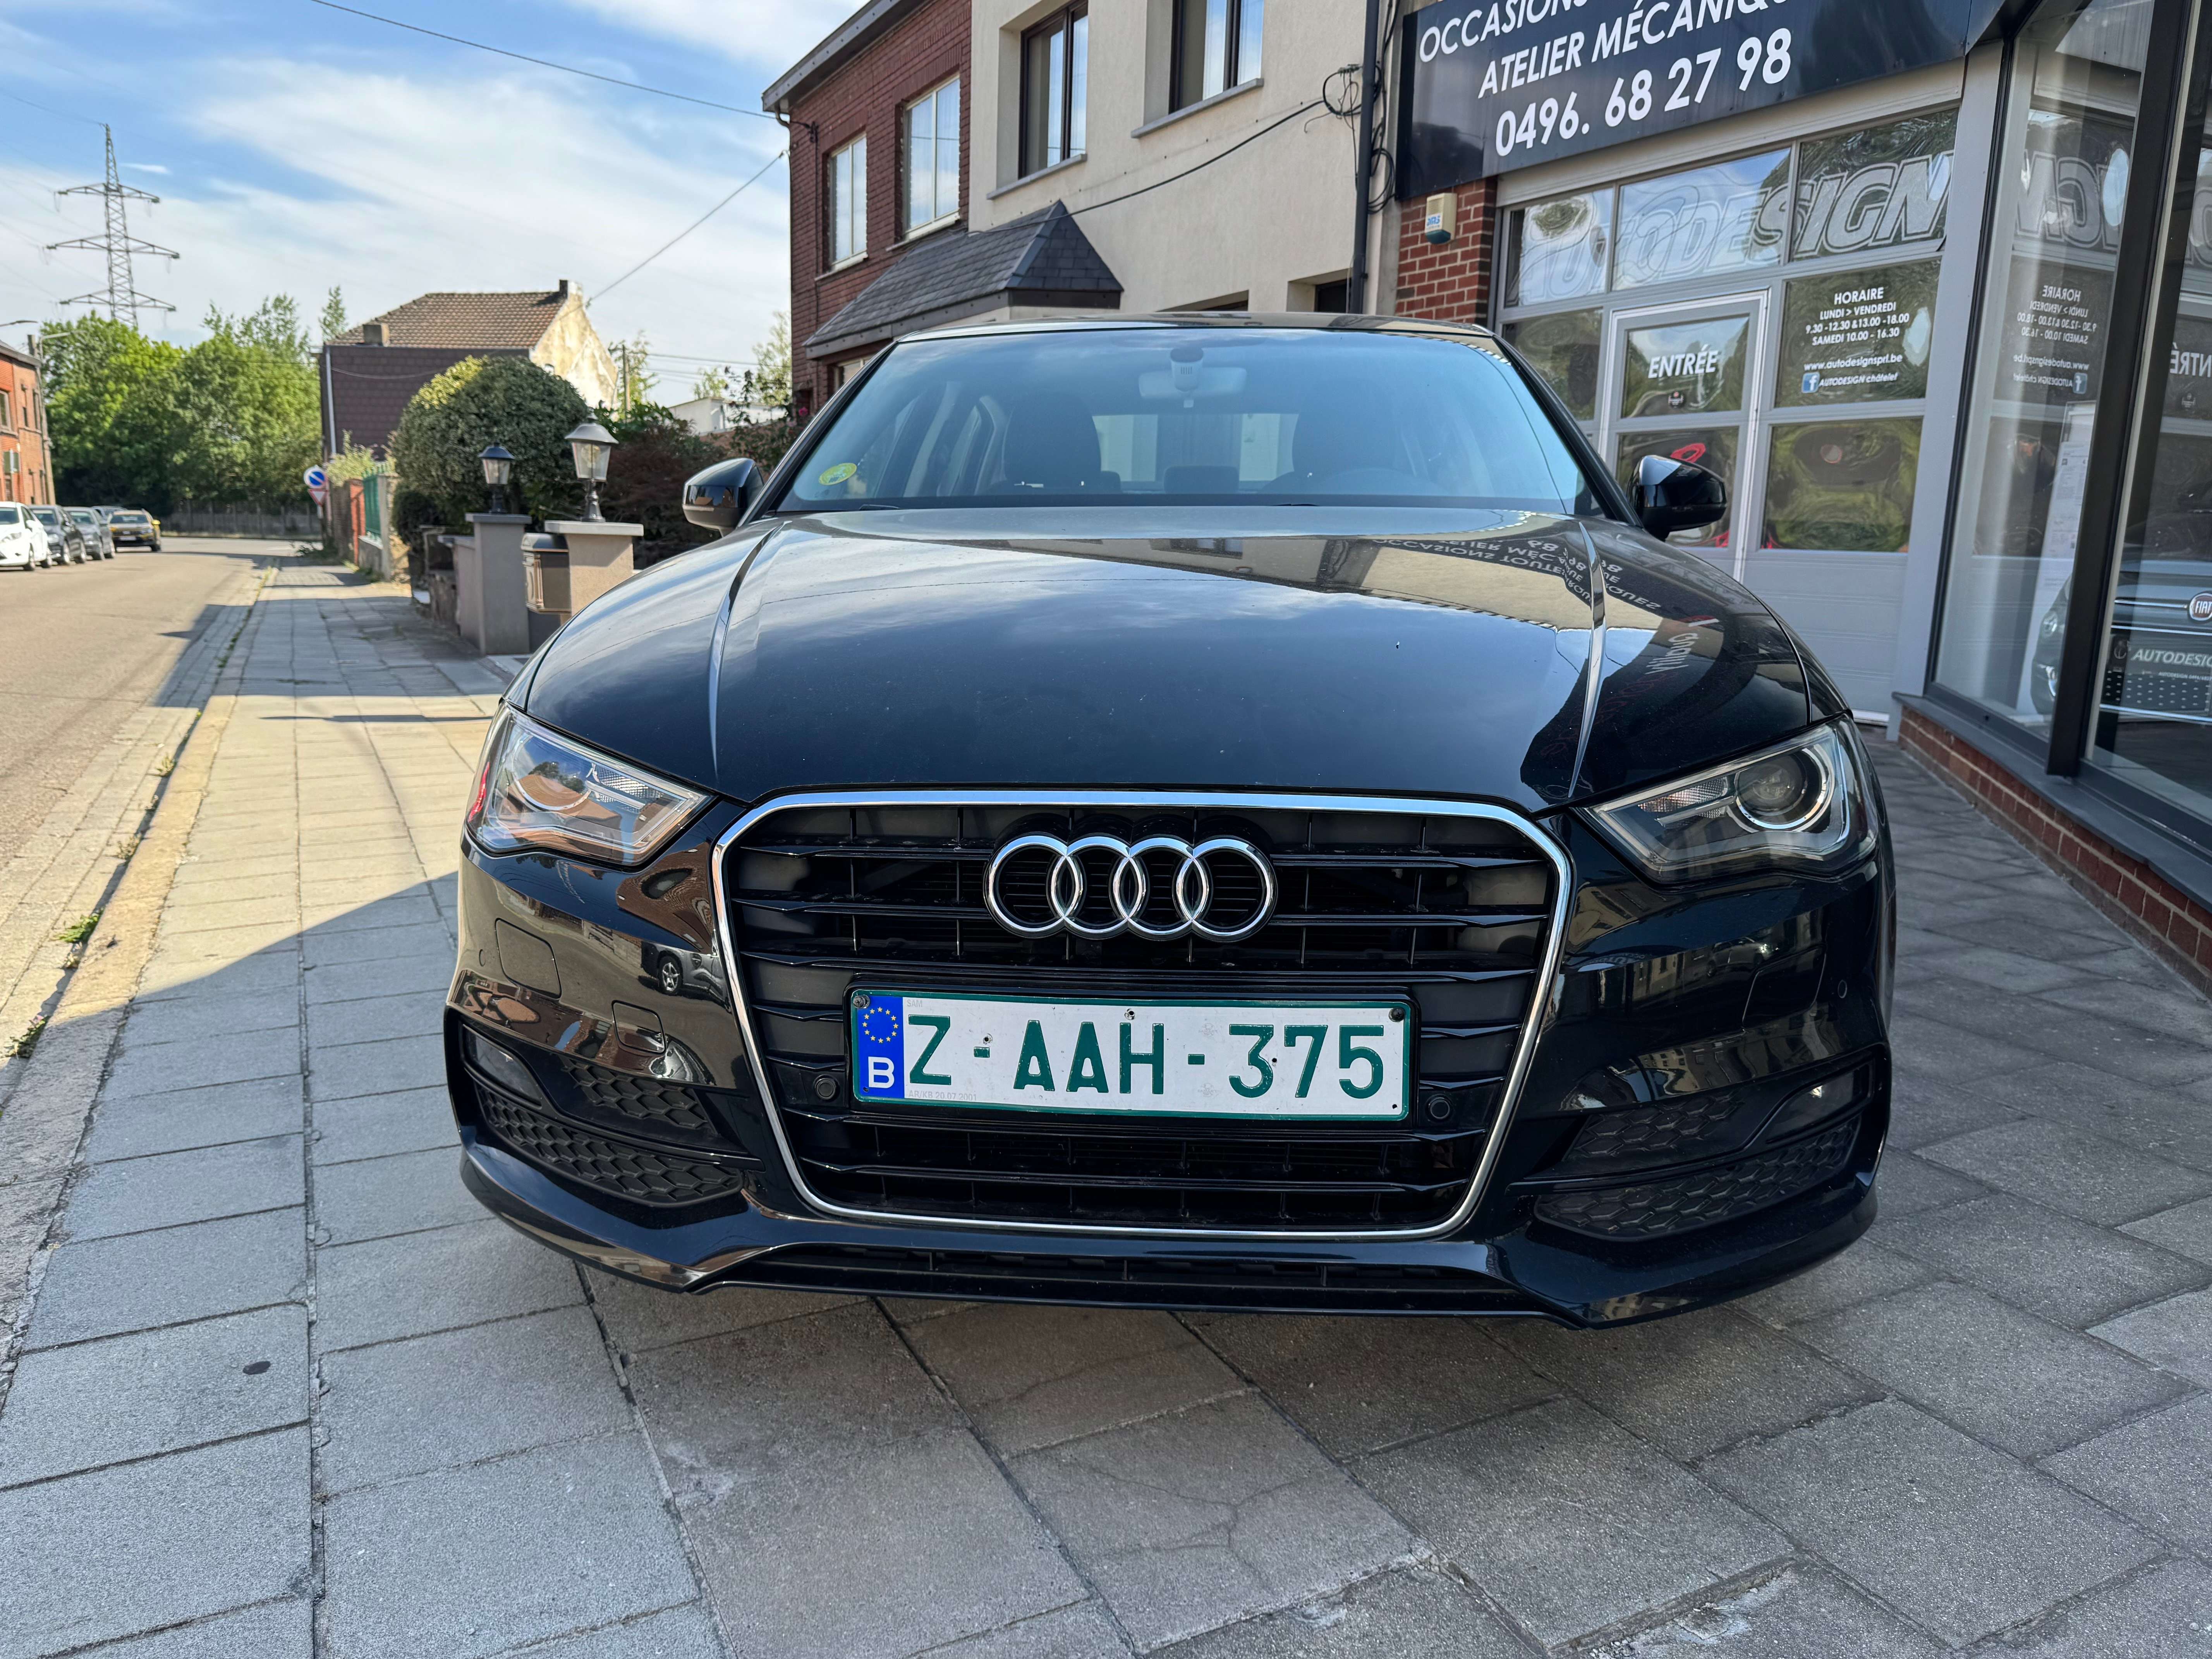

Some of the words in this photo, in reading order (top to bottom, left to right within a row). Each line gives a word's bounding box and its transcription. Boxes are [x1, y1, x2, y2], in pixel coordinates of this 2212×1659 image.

[1420, 0, 1587, 62] OCCASIO
[1478, 31, 1584, 99] ATELIER
[1592, 0, 1787, 63] MÉCANI
[1496, 91, 1589, 156] 0496.
[1605, 70, 1652, 127] 68
[1664, 48, 1721, 112] 27
[1737, 28, 1791, 91] 98
[1834, 287, 1884, 305] HORAIRE
[1820, 308, 1844, 320] LUNDI
[1854, 302, 1896, 315] VENDREDI
[1812, 335, 1844, 346] SAMEDI
[1846, 331, 1868, 342] 10.00
[1877, 327, 1899, 339] 16.30
[1648, 344, 1719, 379] ENTRÉE
[1819, 375, 1865, 387] AUTODESIGN
[2195, 601, 2212, 614] FIAT
[907, 999, 922, 1008] SAM
[868, 1056, 895, 1089] B
[909, 1090, 933, 1099] AR/KB
[935, 1091, 977, 1101] 20.07.2001
